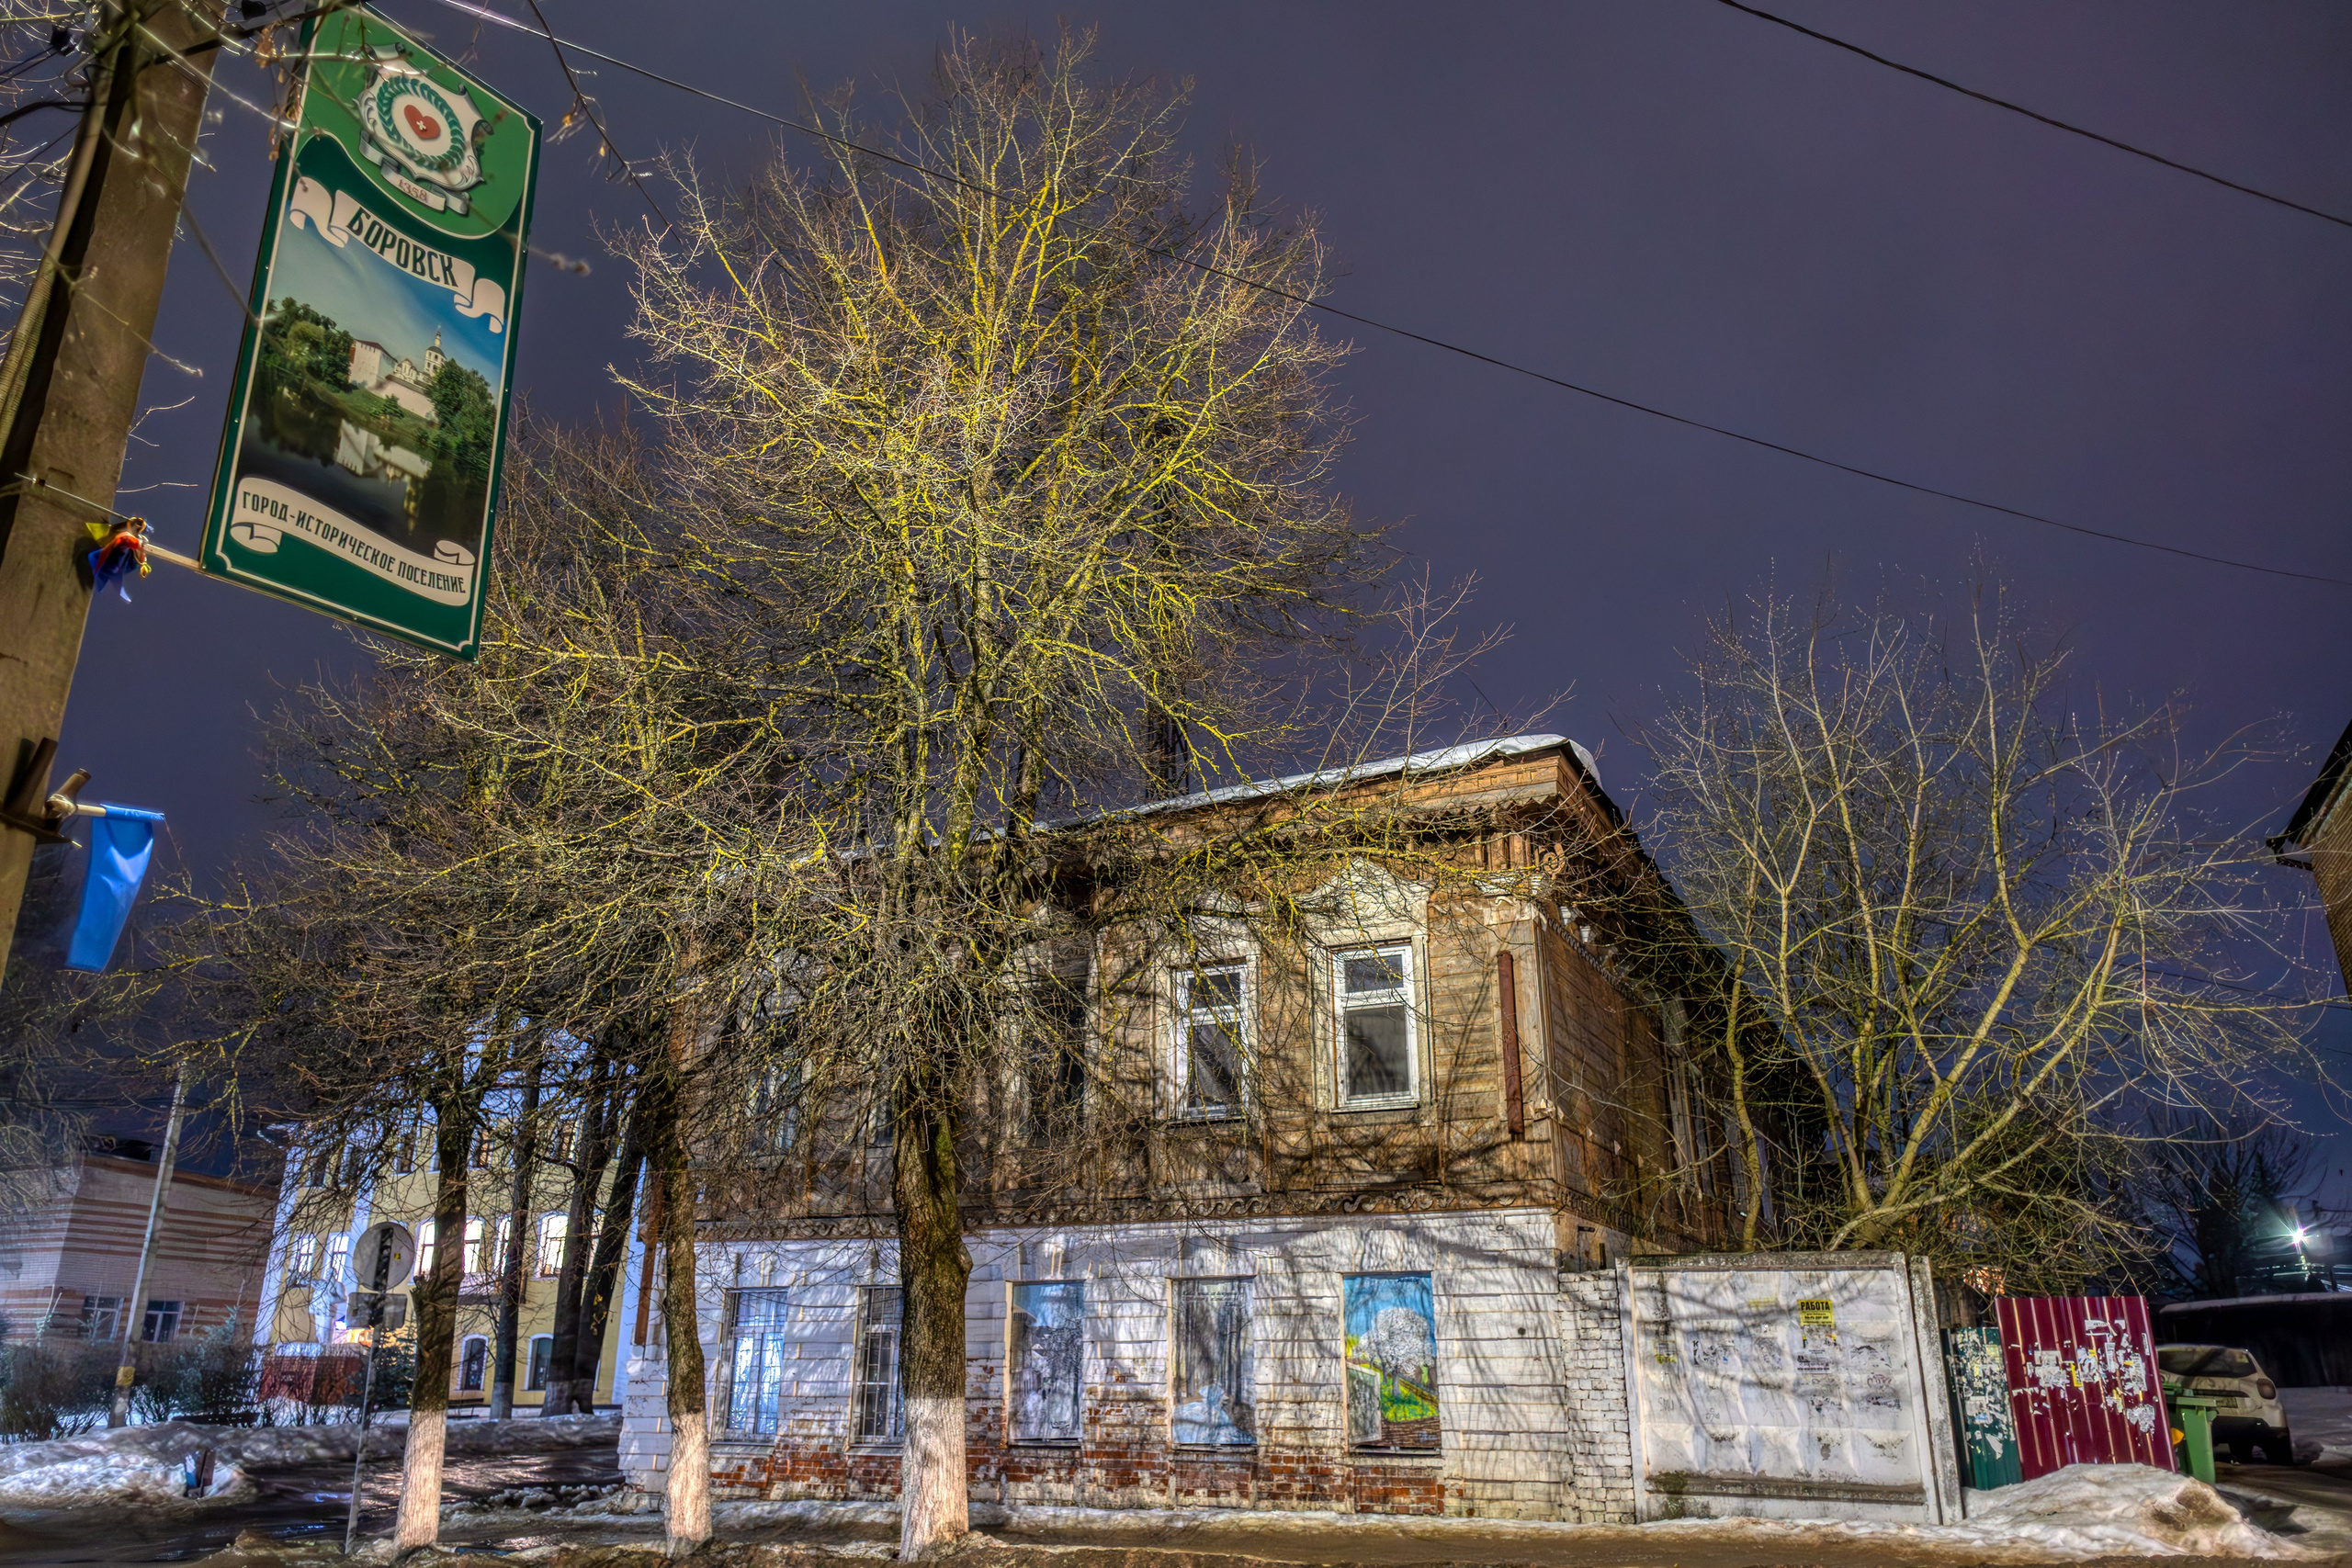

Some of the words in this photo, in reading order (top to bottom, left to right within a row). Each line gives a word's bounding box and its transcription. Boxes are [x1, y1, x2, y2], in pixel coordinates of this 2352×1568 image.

[399, 179, 428, 203] 1358
[345, 207, 458, 288] БОРОВСК
[243, 491, 396, 573] ГОРОД-ИСТОРИЧЕСКОЕ
[397, 559, 467, 593] ПОСЕЛЕНИЕ
[1801, 1301, 1830, 1311] РАБОТА
